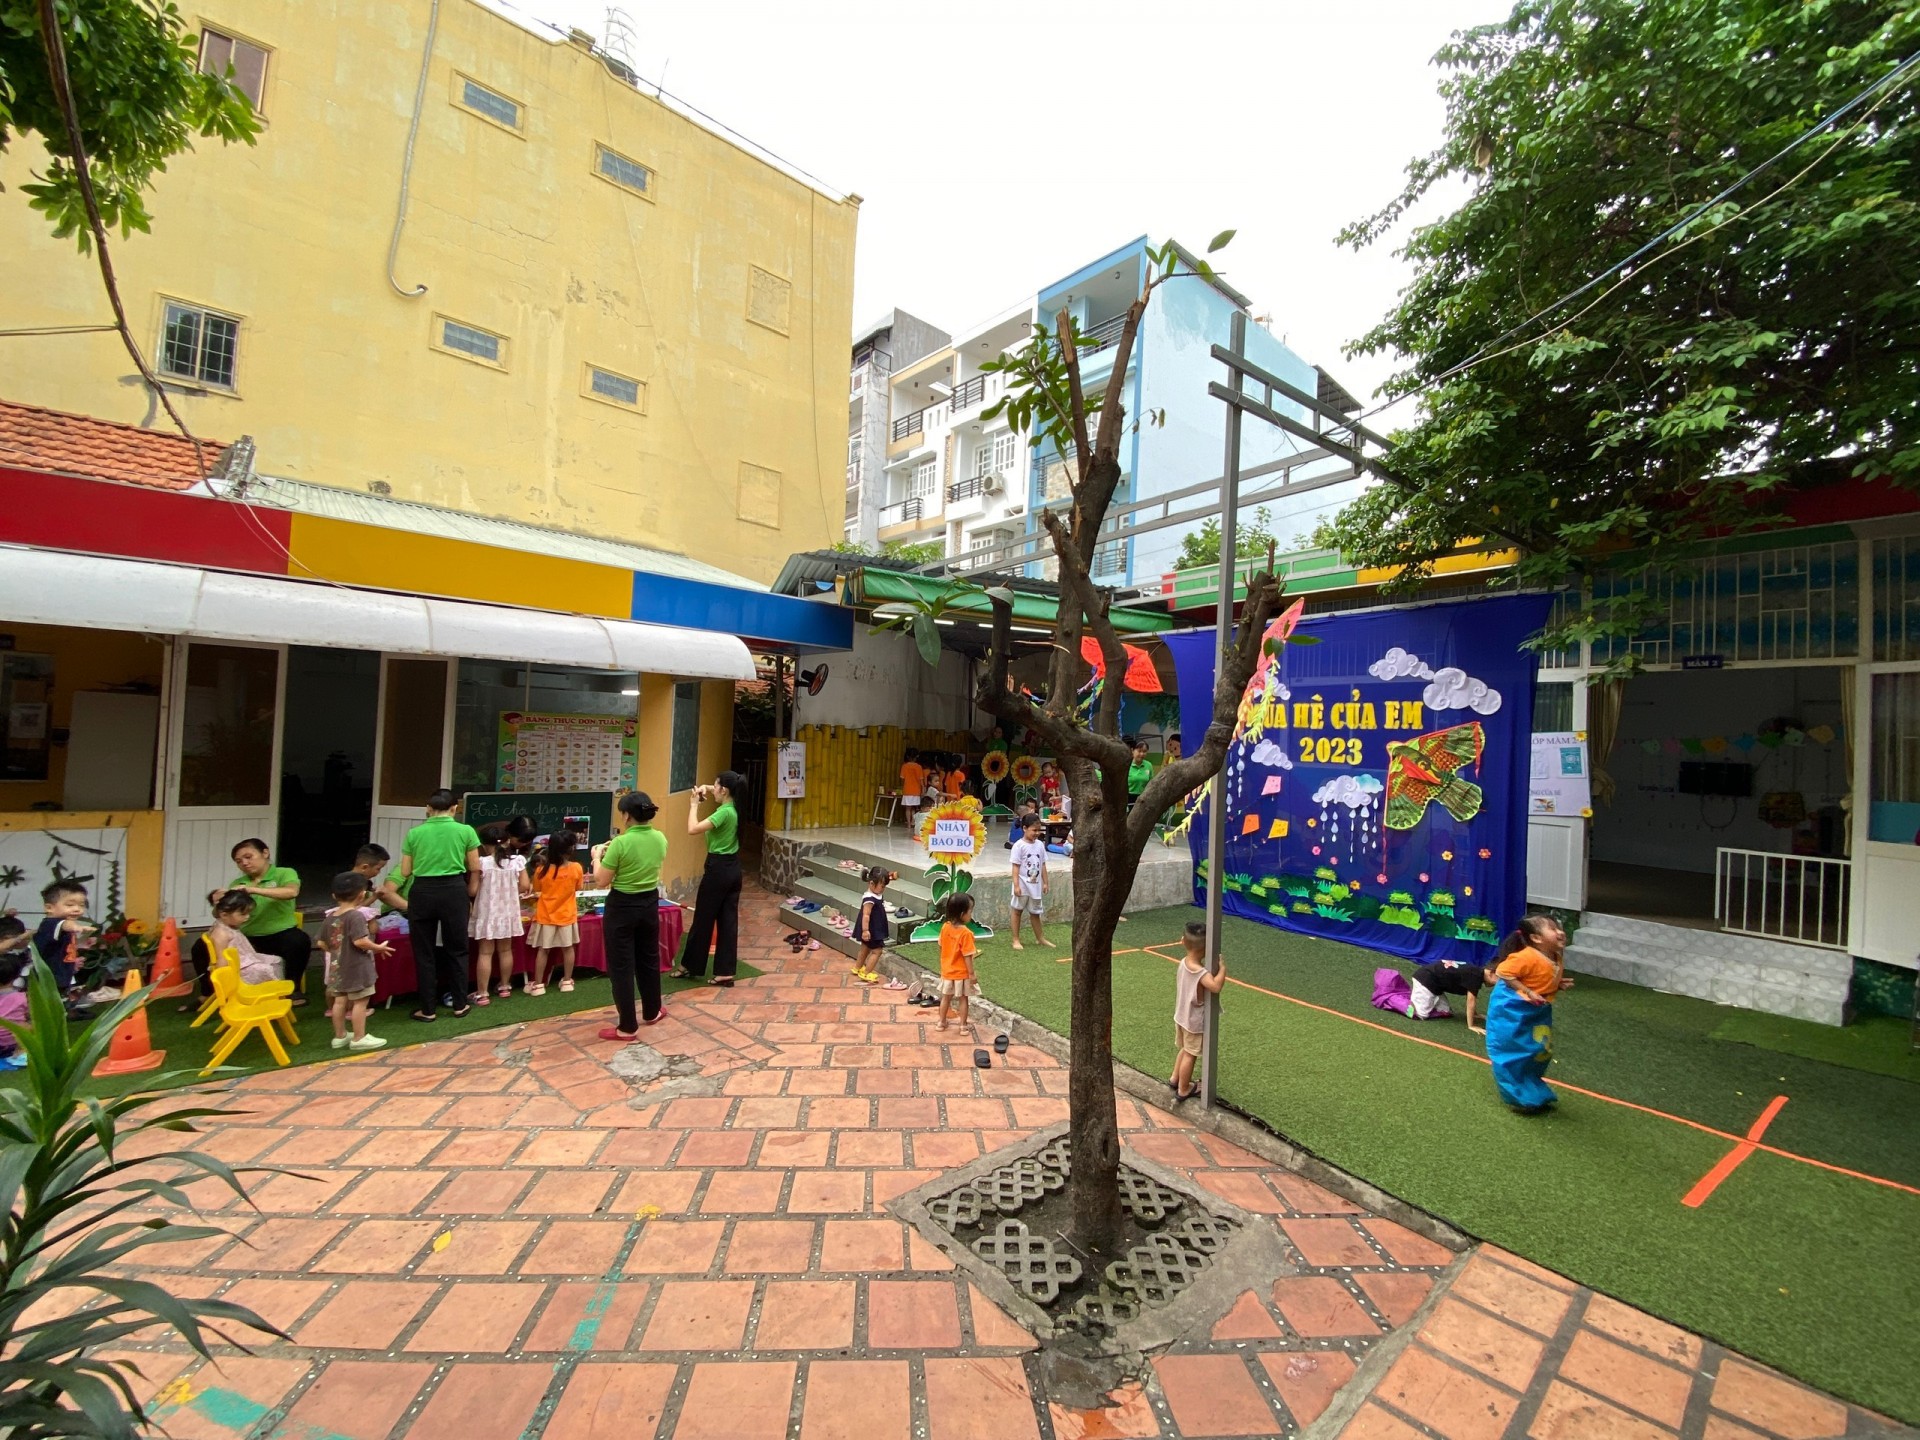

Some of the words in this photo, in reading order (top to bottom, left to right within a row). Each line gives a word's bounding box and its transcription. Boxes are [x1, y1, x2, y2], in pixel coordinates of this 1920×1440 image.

[1331, 689, 1377, 730] CỦA
[1384, 701, 1424, 730] EM
[1300, 737, 1363, 766] 2023
[931, 837, 953, 846] BAO
